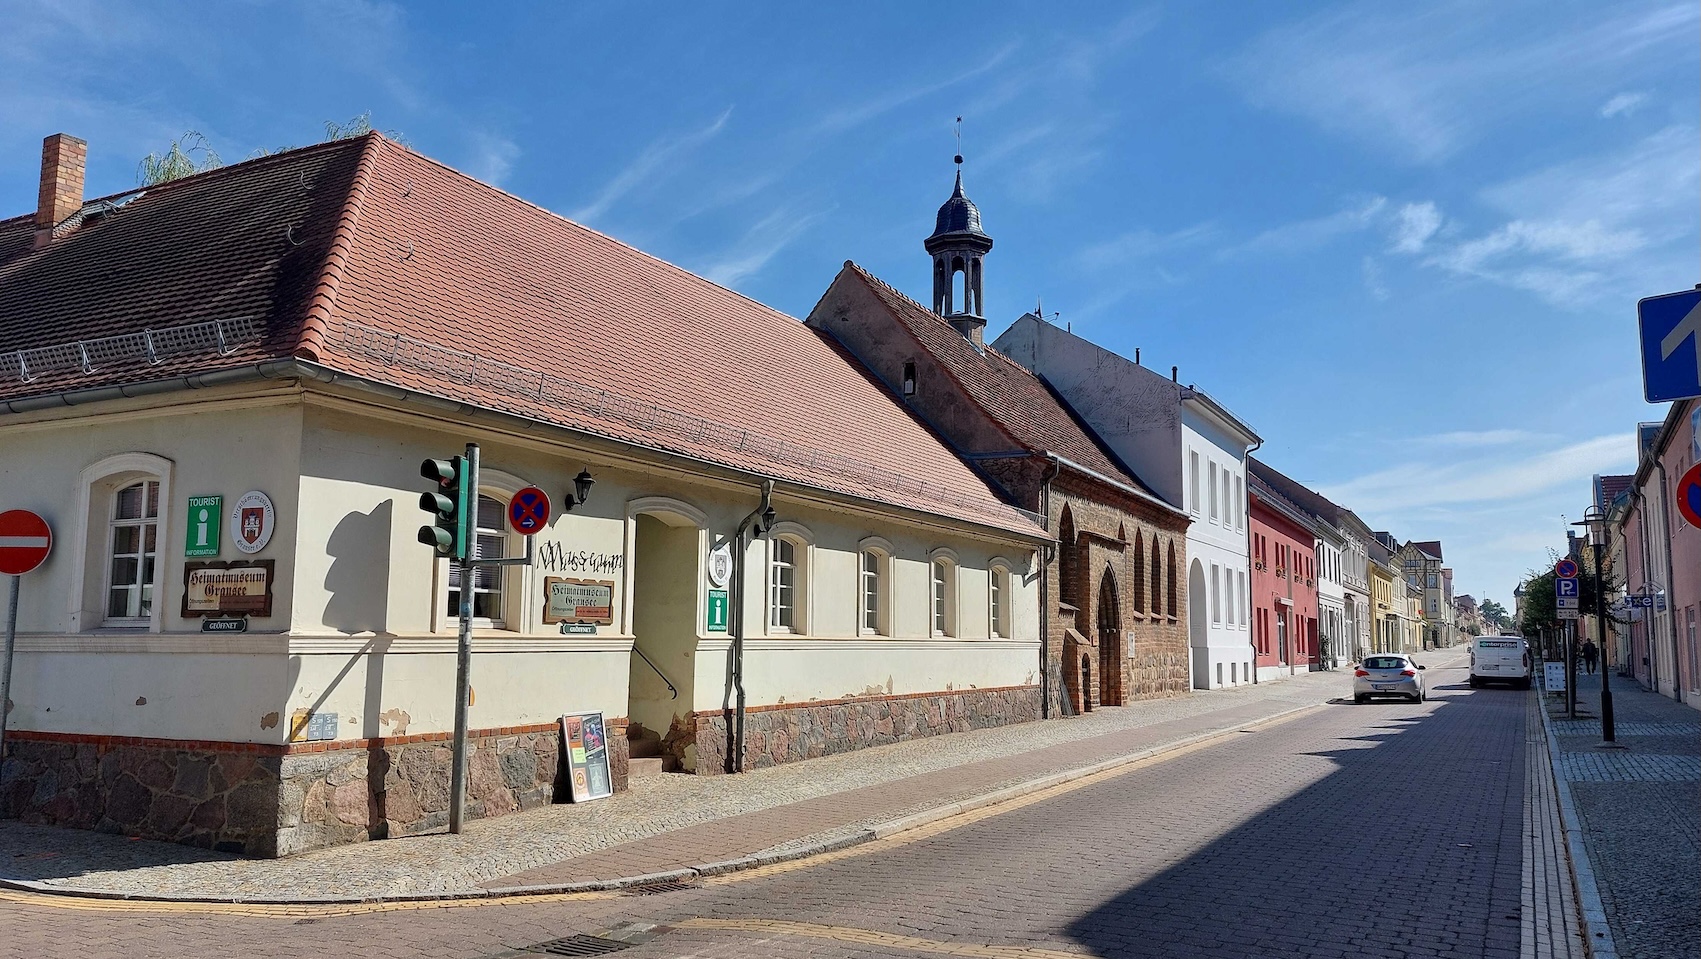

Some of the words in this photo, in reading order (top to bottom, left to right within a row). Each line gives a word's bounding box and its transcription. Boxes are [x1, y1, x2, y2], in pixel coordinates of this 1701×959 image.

[189, 497, 220, 507] TOURIST
[190, 571, 265, 585] Heimatmuseum
[204, 584, 247, 597] Gransee
[552, 585, 609, 597] Heimatmuseum
[1561, 581, 1573, 595] P
[565, 596, 597, 606] Gransee
[209, 622, 238, 630] GEÖFFNET
